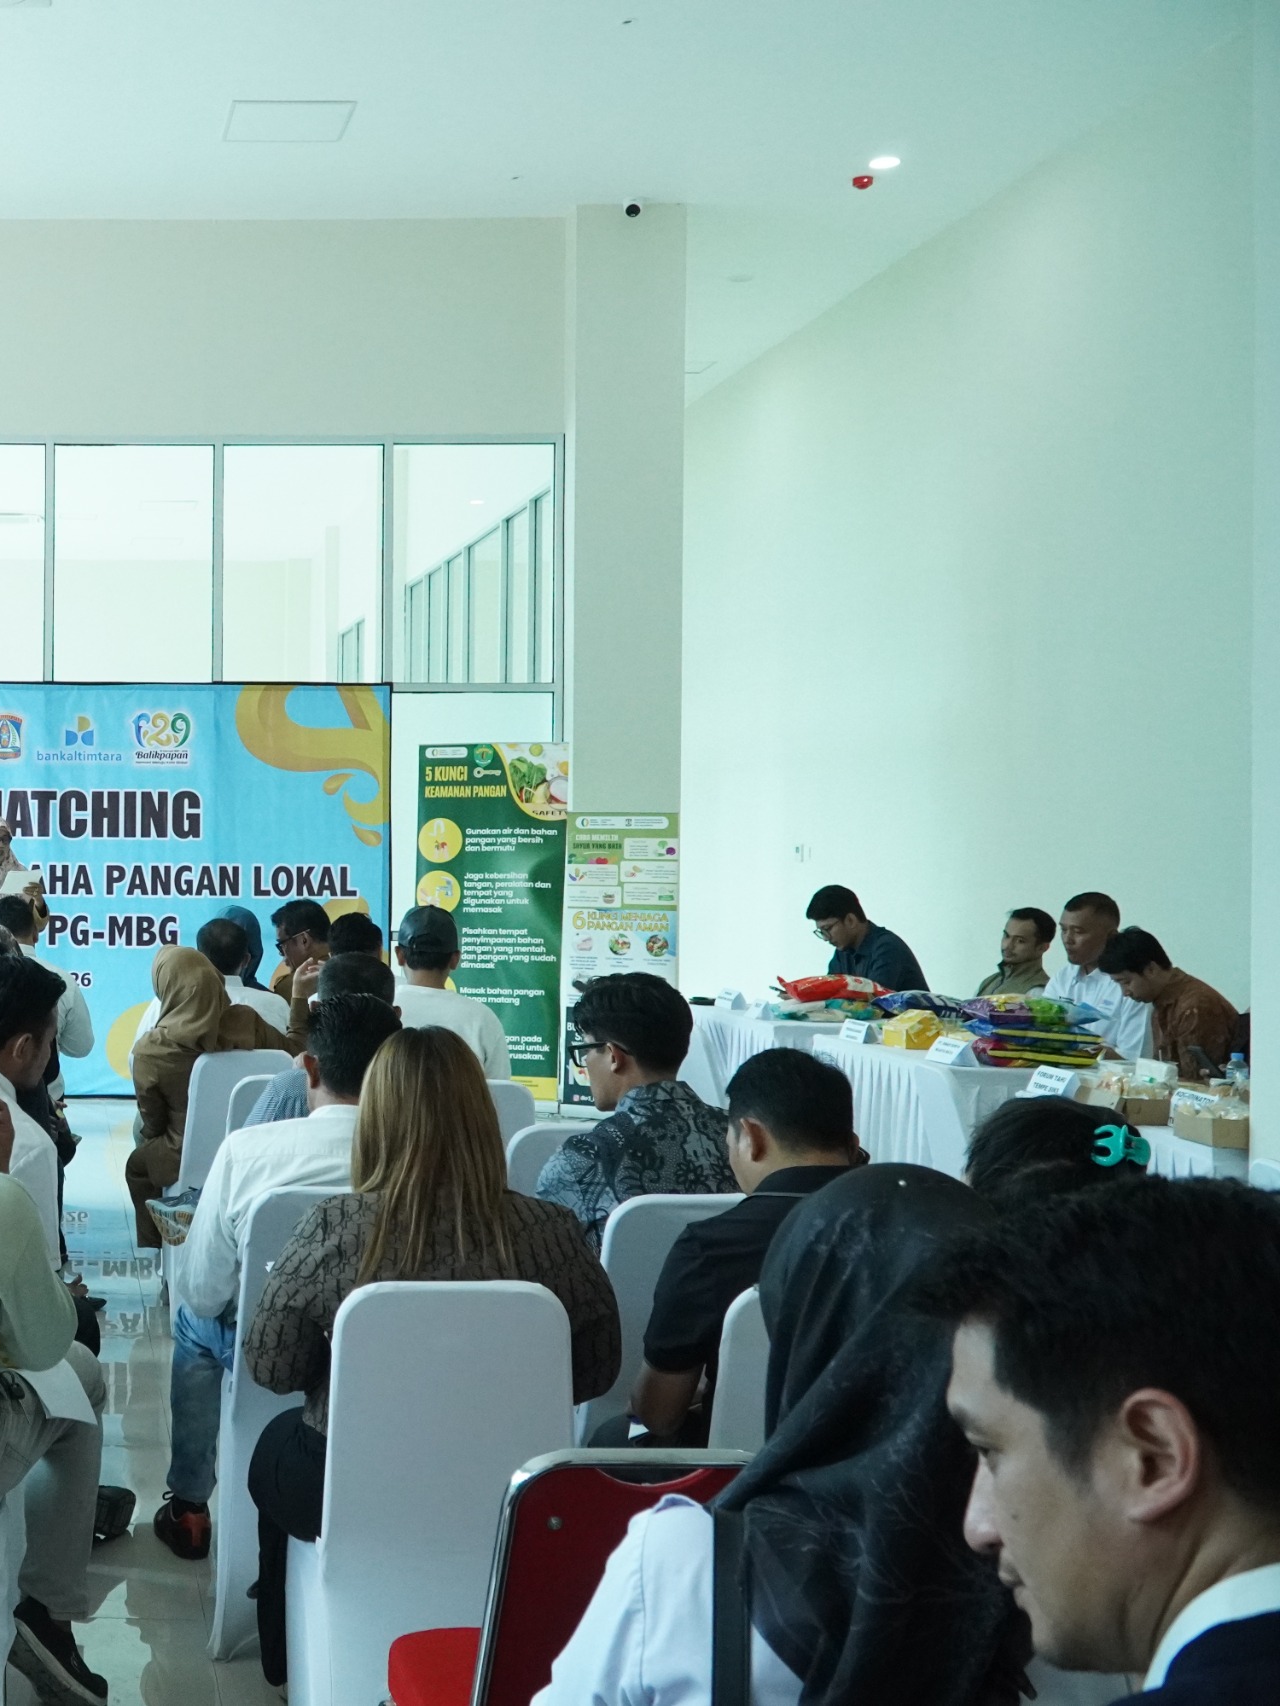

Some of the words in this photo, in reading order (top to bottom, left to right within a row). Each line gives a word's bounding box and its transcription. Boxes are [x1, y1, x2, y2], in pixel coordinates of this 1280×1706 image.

[37, 751, 122, 761] bankaltimtara
[135, 750, 189, 760] Balikpapan
[426, 767, 432, 781] 5
[434, 766, 468, 781] KUNCI
[425, 786, 471, 798] KEAMANAN
[473, 785, 507, 797] PANGAN
[502, 827, 512, 835] air
[465, 837, 496, 845] pangan
[518, 836, 543, 844] bersih
[106, 865, 240, 896] PANGAN
[254, 866, 357, 896] LOKAL
[464, 872, 484, 880] Jaga
[464, 881, 493, 889] tangan,
[495, 881, 533, 889] peralatan
[493, 890, 513, 898] yang
[463, 898, 505, 906] digunakan
[587, 911, 618, 920] KUNCI
[572, 911, 586, 930] 6
[587, 921, 633, 931] PANGAN
[636, 922, 669, 932] AMAN
[499, 928, 528, 936] tempat
[462, 936, 516, 945] penyimpanan
[462, 945, 492, 953] pangan
[478, 954, 508, 962] pangan
[509, 955, 529, 963] yang
[488, 997, 520, 1006] matang
[521, 1035, 542, 1043] pada
[526, 1044, 549, 1052] untuk
